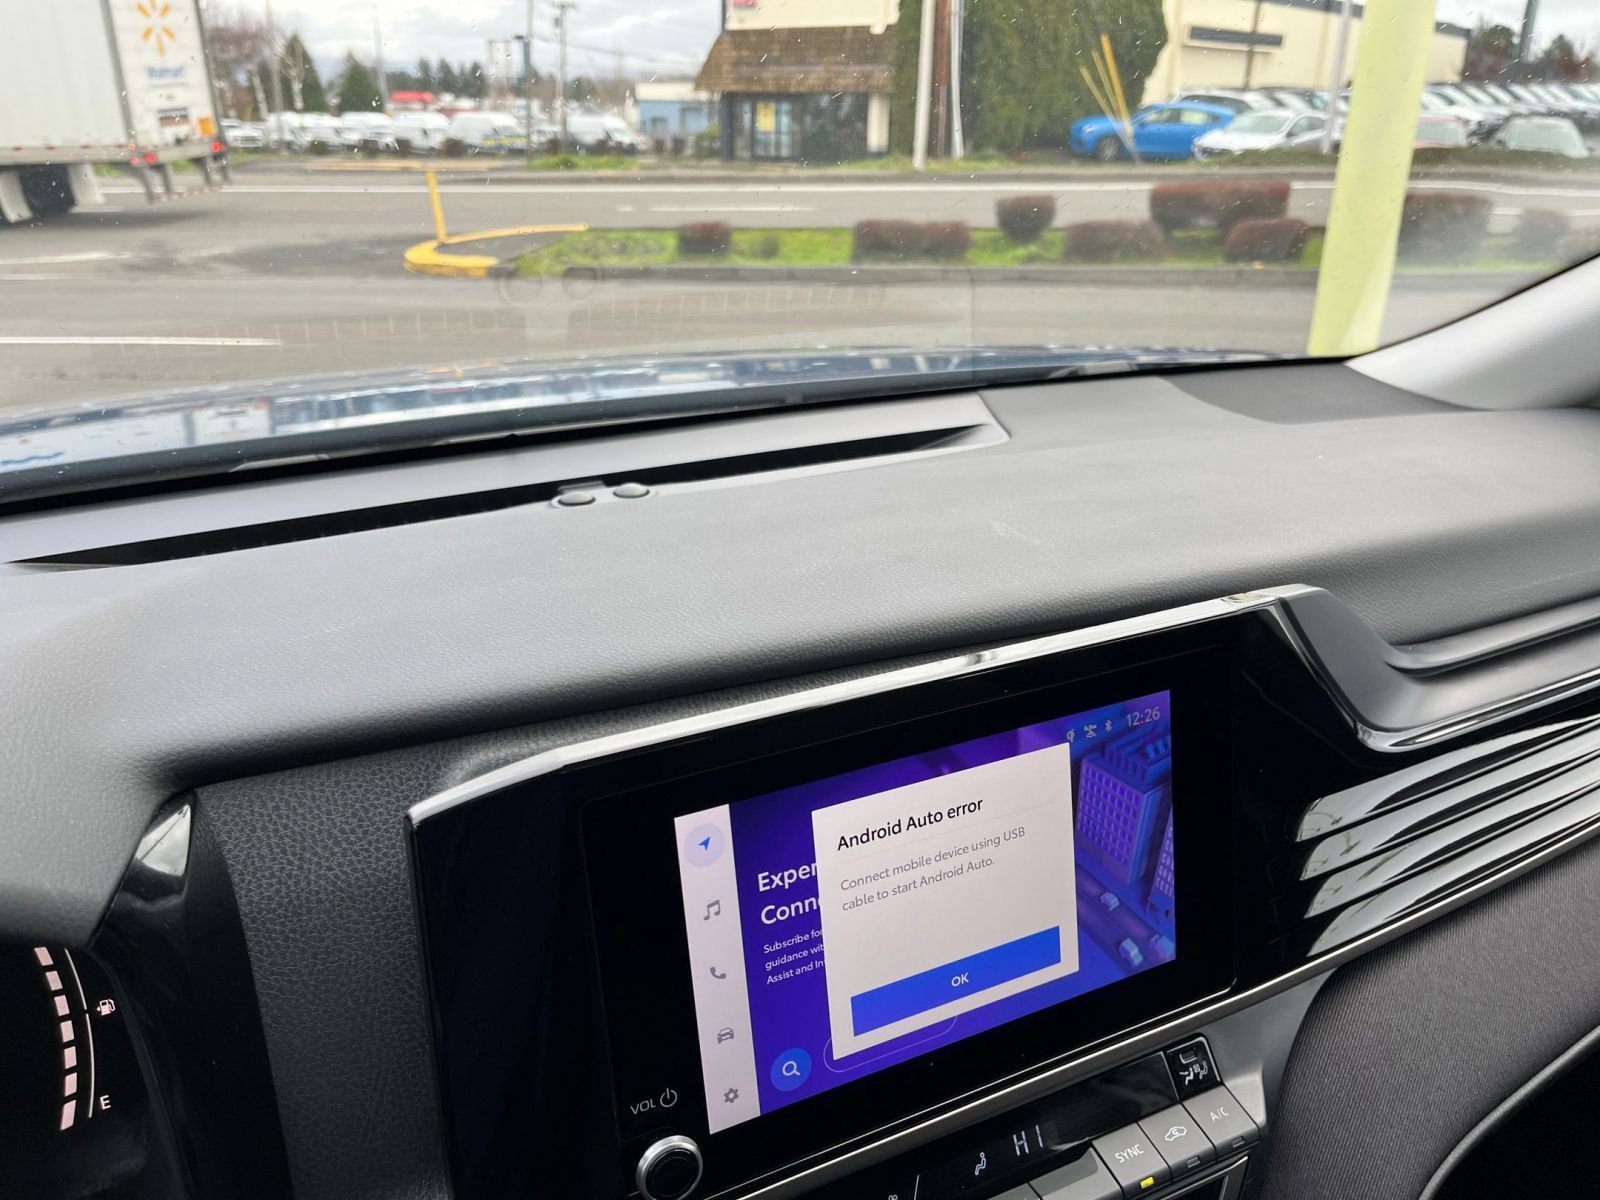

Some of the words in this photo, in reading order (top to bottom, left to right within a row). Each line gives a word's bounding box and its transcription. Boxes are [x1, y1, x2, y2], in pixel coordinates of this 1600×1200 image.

[1126, 705, 1160, 727] 12:26
[837, 818, 902, 851] Android
[906, 811, 943, 831] Auto
[947, 799, 983, 819] error
[840, 868, 890, 891] Connect
[892, 855, 932, 876] mobile
[934, 845, 969, 863] device
[971, 836, 1001, 852] using
[1003, 826, 1025, 842] USB
[757, 862, 818, 892] Exper
[842, 893, 875, 911] cable
[876, 890, 889, 900] to
[891, 880, 918, 896] start
[919, 864, 964, 887] Android
[966, 857, 995, 873] Auto.
[760, 896, 820, 925] Conn
[763, 933, 810, 954] Subscribe
[765, 953, 809, 972] guidance
[766, 969, 794, 985] Assist
[795, 961, 814, 975] and
[814, 959, 825, 969] In
[951, 971, 969, 988] OK
[99, 1094, 112, 1111] E
[630, 1098, 656, 1115] VOL
[1209, 1106, 1230, 1122] A/C
[1012, 1124, 1044, 1157] HI
[1114, 1143, 1145, 1164] SYNC
